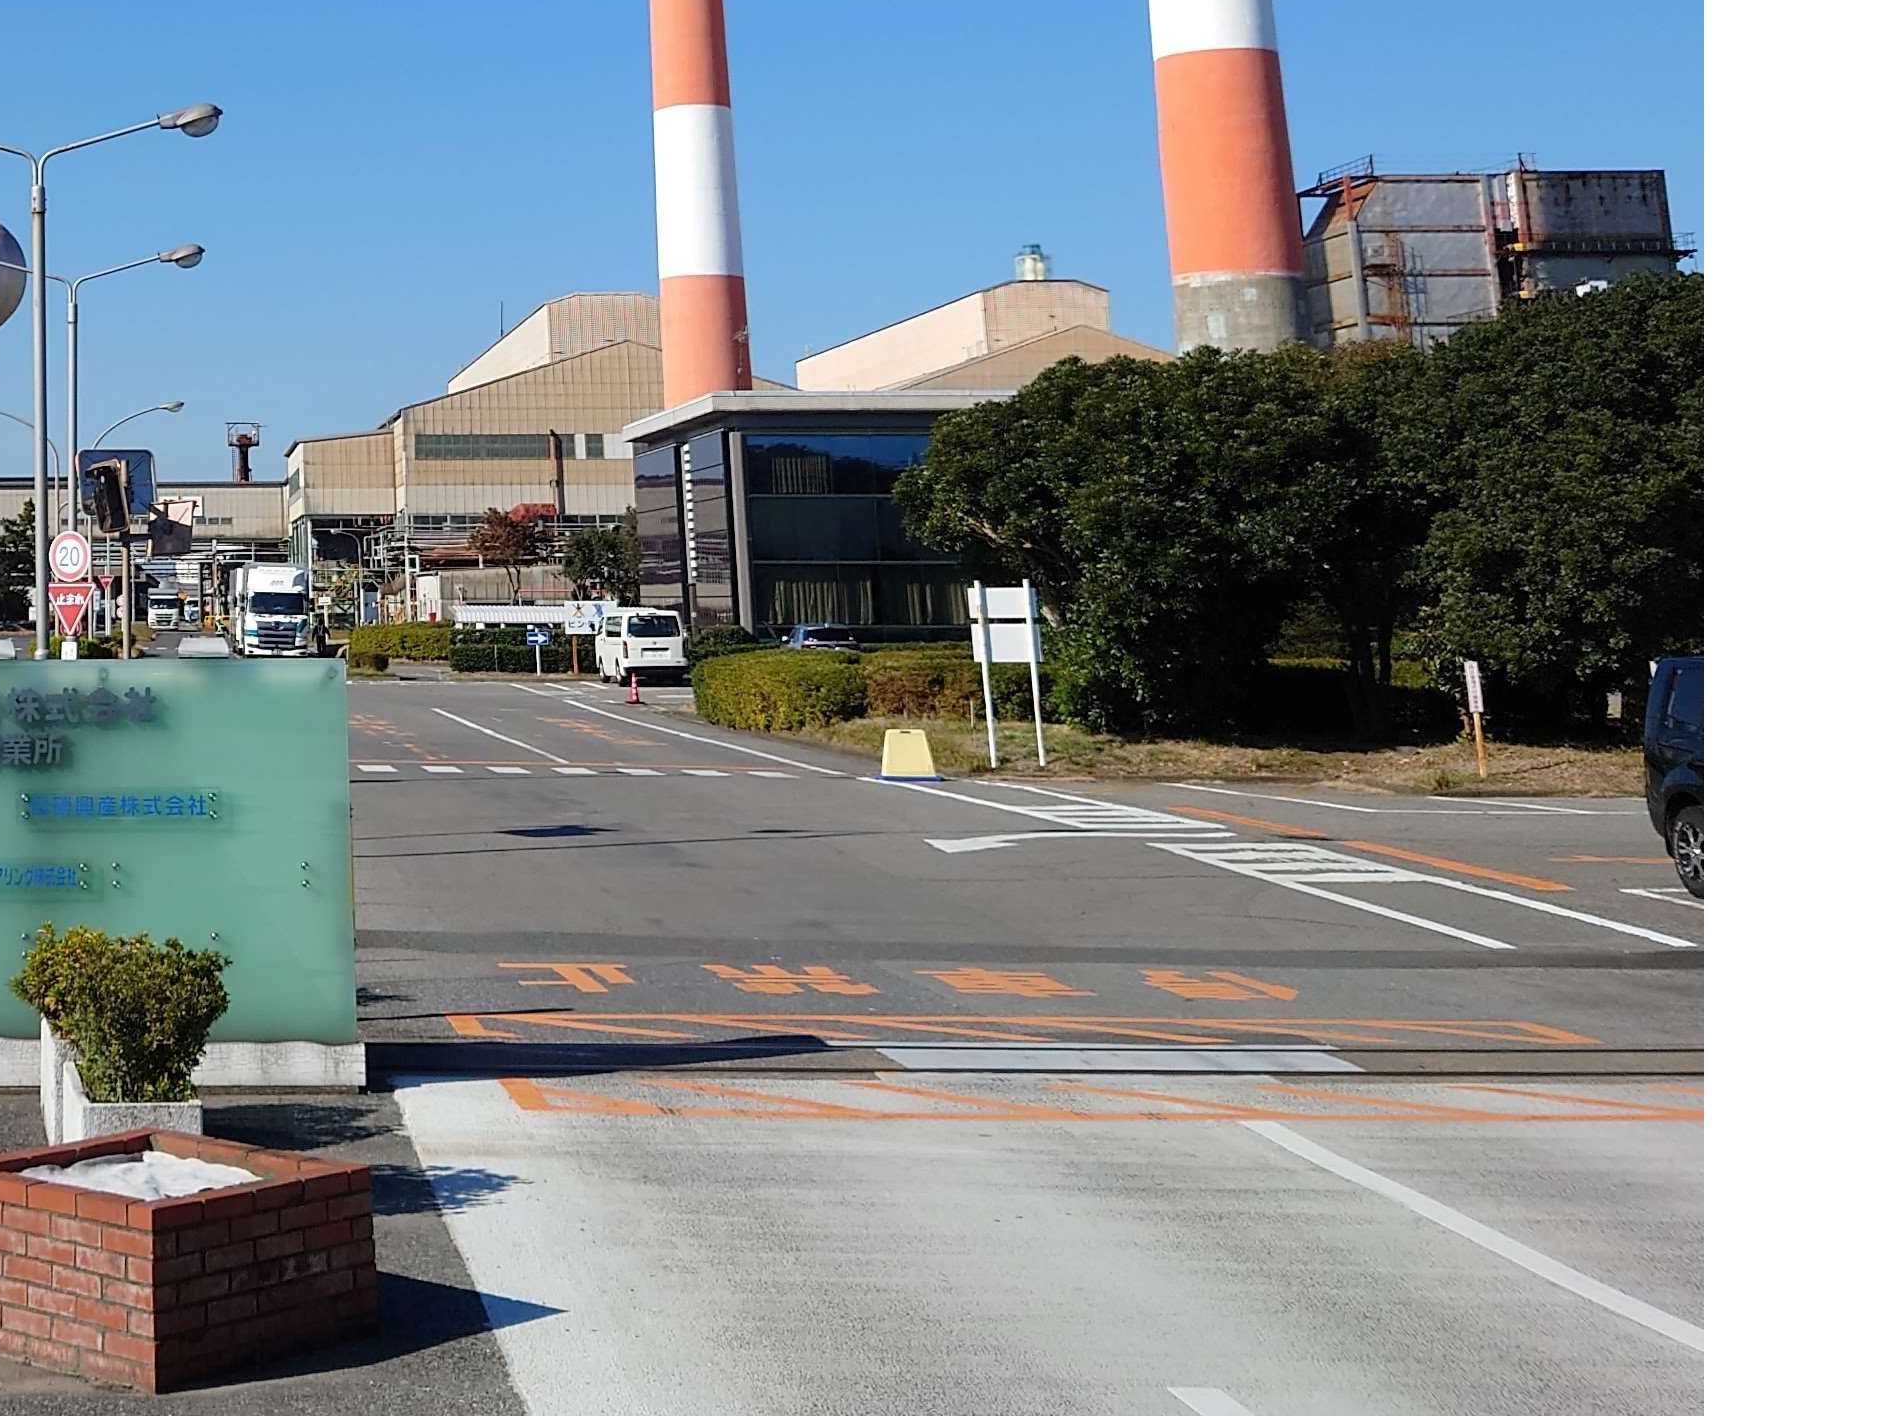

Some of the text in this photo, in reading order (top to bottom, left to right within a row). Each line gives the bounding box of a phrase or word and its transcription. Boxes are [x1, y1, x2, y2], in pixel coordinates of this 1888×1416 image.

[59, 546, 80, 567] 20
[56, 592, 85, 605] 止まれ
[31, 795, 207, 816] 硝興産株式会社
